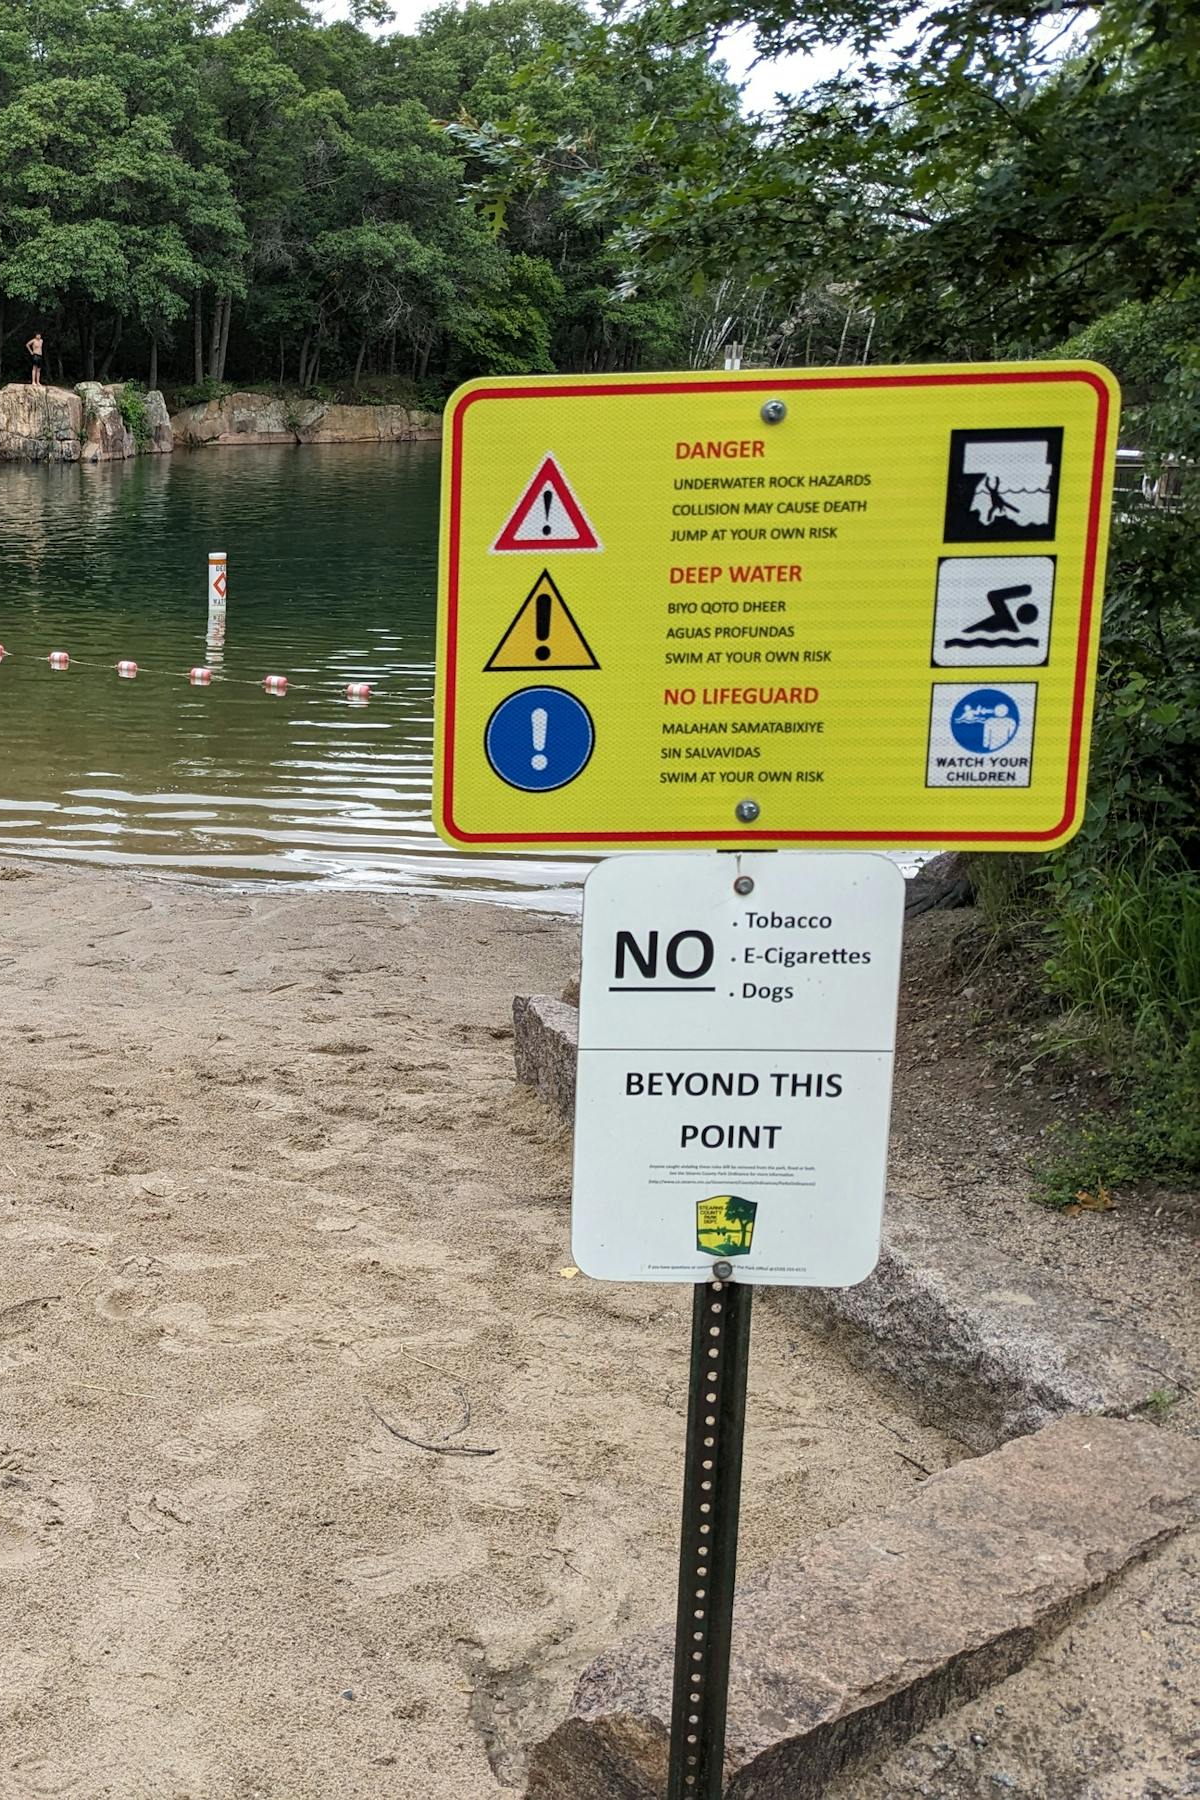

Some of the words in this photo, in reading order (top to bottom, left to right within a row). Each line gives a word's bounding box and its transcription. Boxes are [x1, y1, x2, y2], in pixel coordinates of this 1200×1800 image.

[676, 441, 764, 459] DANGER
[674, 477, 765, 490] UNDERWATER
[769, 476, 805, 488] ROCK
[809, 474, 871, 487] HAZARDS
[672, 503, 740, 516] COLLISION
[744, 503, 773, 514] MAY
[777, 502, 820, 513] CAUSE
[824, 501, 867, 512] DEATH
[670, 529, 707, 542] JUMP
[711, 529, 727, 540] AT
[730, 528, 766, 540] YOUR
[770, 528, 804, 539] OWN
[809, 527, 837, 538] RISK
[670, 567, 722, 584] DEEP
[729, 565, 801, 583] WATER
[668, 602, 697, 614] BIYO
[701, 602, 739, 614] QOTO
[743, 601, 786, 612] DHEER
[666, 627, 711, 639] AGUAS
[715, 626, 794, 638] PROFUNDAS
[666, 653, 702, 664] SWIM
[706, 652, 722, 663] AT
[726, 652, 761, 663] YOUR
[765, 651, 799, 662] OWN
[804, 651, 831, 662] RISK
[665, 689, 696, 705] NO
[703, 687, 819, 704] LIFEGUARD
[663, 723, 727, 734] MALAHAN
[732, 722, 824, 733] SAMATABIXIYE
[661, 748, 681, 759] SIN
[685, 747, 760, 758] SALVAVIDAS
[936, 757, 984, 767] WATCH
[990, 757, 1027, 767] YOUR
[660, 772, 697, 783] SWIM
[701, 772, 716, 782] AT
[719, 771, 754, 782] YOUR
[758, 771, 792, 782] OWN
[796, 771, 824, 782] RISK
[947, 772, 1015, 781] CHILDREN
[746, 912, 832, 928] Tobacco
[615, 930, 714, 979] NO
[745, 947, 870, 967] E-Cigarettes
[743, 983, 793, 1002] Dogs
[626, 1073, 759, 1096] BEYOND
[770, 1074, 842, 1097] THIS
[681, 1125, 782, 1149] POINT
